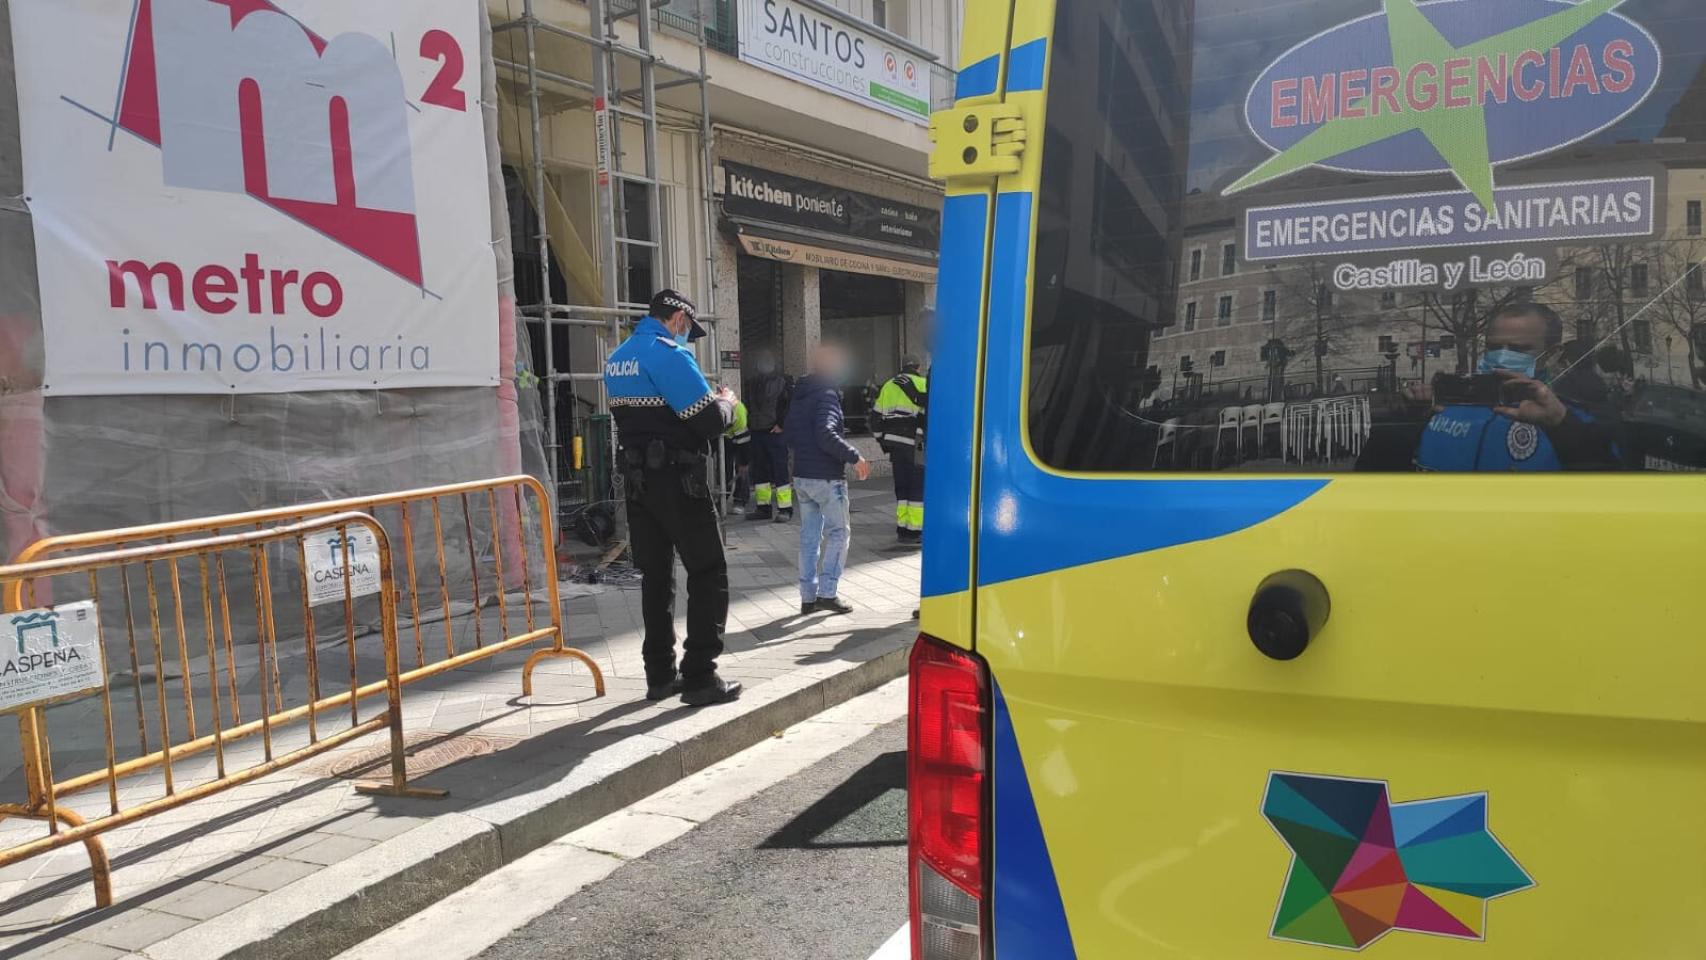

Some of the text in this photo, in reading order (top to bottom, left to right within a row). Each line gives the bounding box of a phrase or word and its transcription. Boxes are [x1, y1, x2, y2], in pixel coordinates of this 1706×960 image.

[764, 0, 866, 69] SANTOS
[765, 41, 866, 91] construcciones
[1270, 39, 1636, 128] EMERGENCIAS
[730, 174, 844, 218] kitchen poniente
[1256, 190, 1642, 249] EMERGENCIAS SANITARIAS
[105, 253, 344, 318] metro
[1334, 253, 1545, 291] Castilla y León
[122, 326, 430, 373] inmobiliaria
